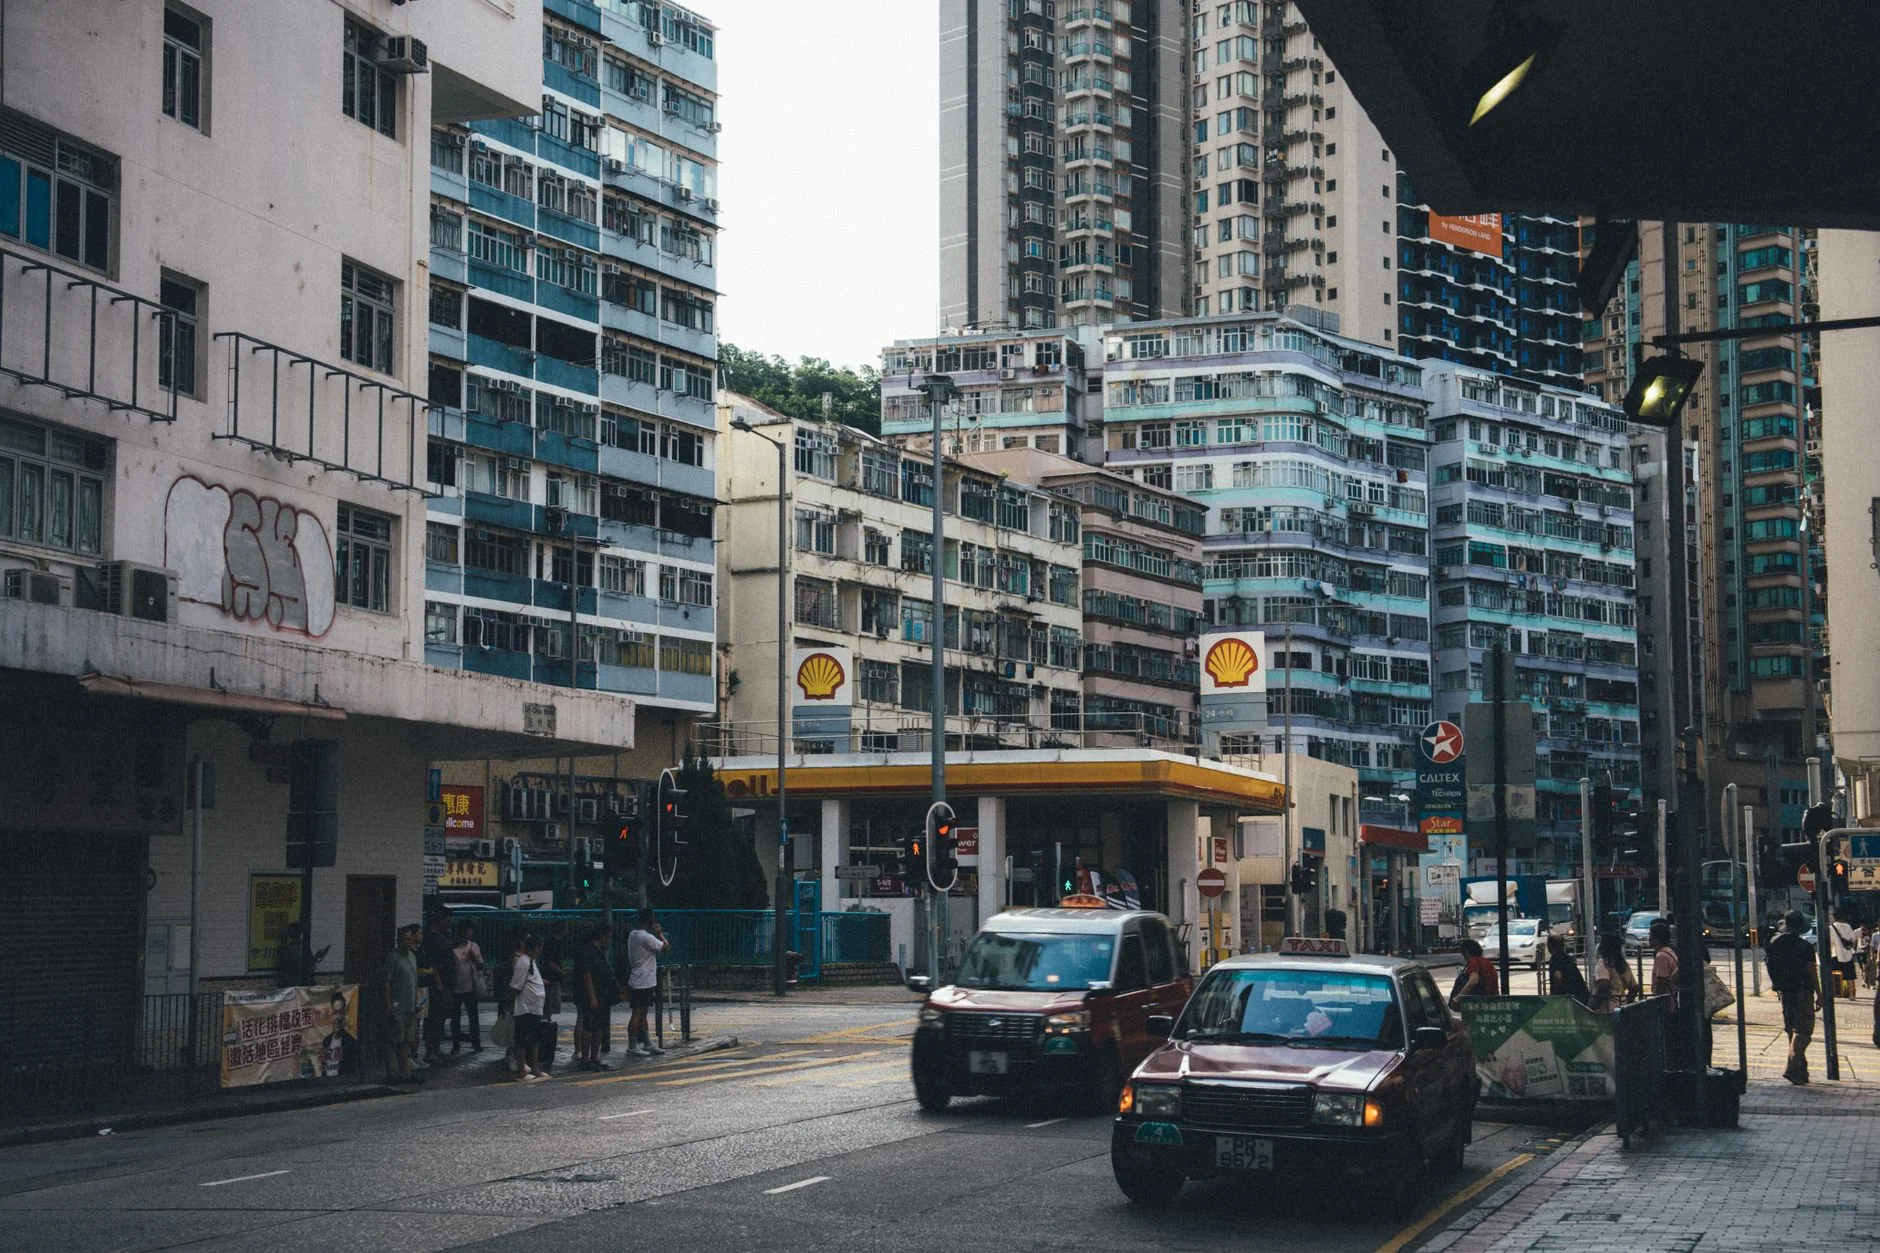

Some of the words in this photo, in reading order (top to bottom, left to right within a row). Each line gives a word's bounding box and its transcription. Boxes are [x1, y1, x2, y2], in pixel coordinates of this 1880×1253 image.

[1441, 222, 1448, 230] by
[1449, 223, 1478, 237] HENDERSON
[1478, 231, 1491, 240] LAND
[1205, 709, 1216, 718] 24
[1419, 773, 1460, 783] CALTEX
[442, 793, 470, 815] 惠康
[1430, 816, 1452, 829] Star
[1287, 939, 1341, 953] TAXI
[1232, 1138, 1256, 1156] PR
